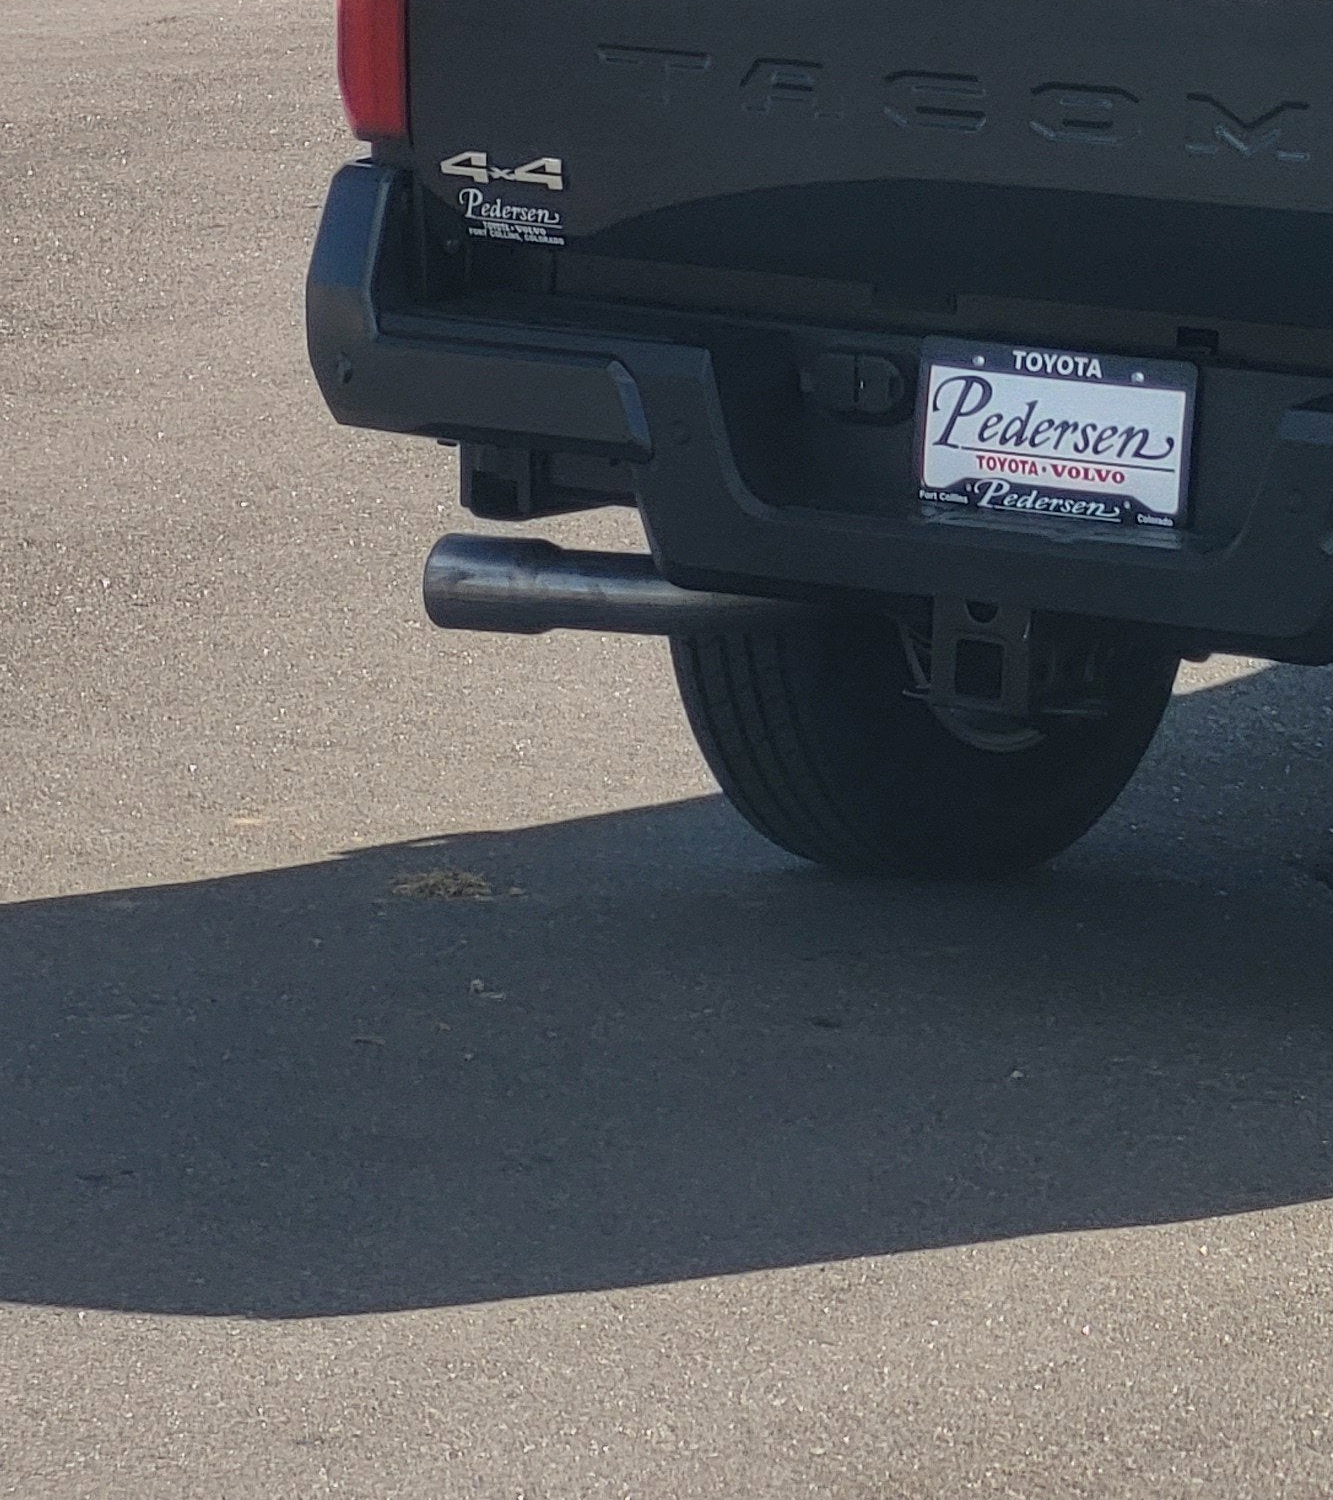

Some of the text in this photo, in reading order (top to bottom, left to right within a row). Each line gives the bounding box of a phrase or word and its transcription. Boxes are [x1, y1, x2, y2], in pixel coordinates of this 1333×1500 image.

[458, 188, 561, 224] Pedersen
[1012, 350, 1103, 379] TOYOTA
[932, 375, 1175, 460] Pedersen
[976, 455, 1126, 485] TOYOTA VOLVO
[973, 477, 1121, 518] Pedersen
